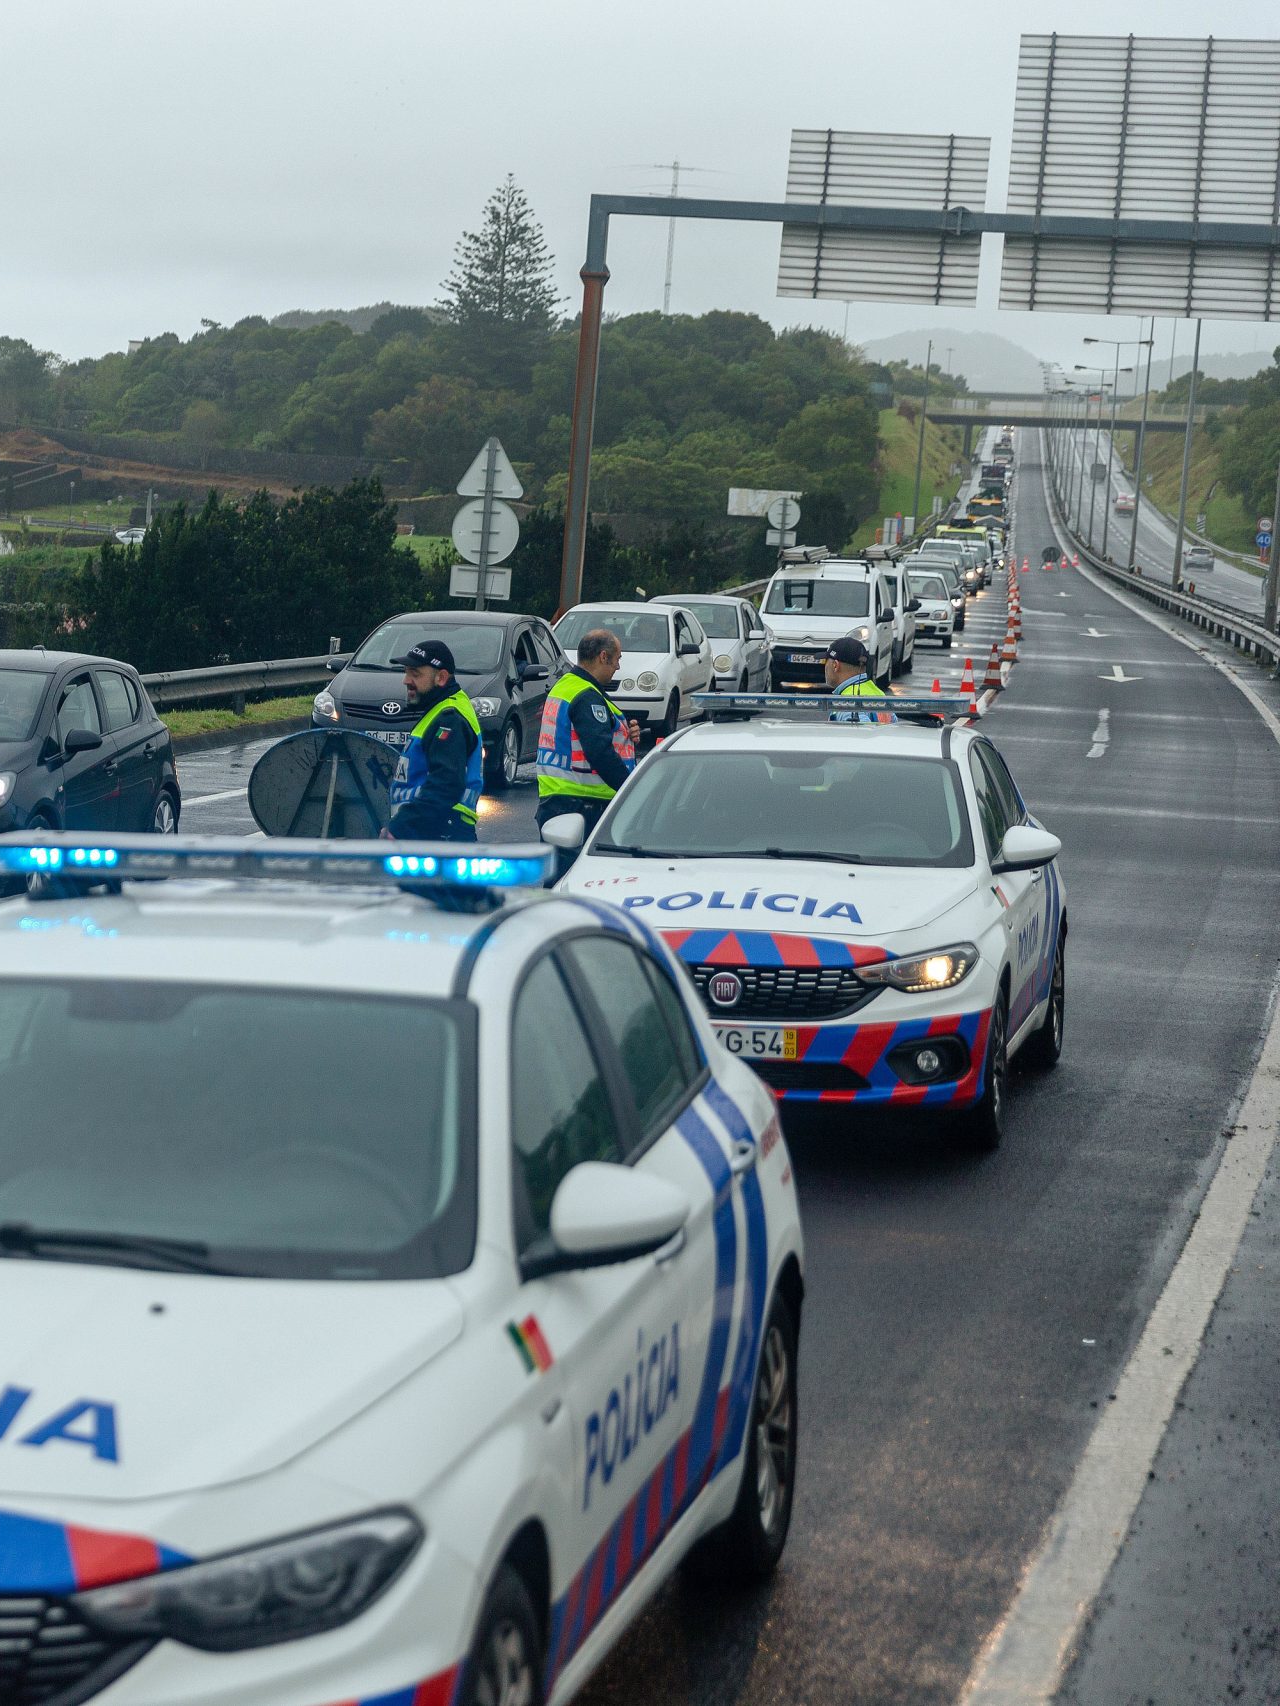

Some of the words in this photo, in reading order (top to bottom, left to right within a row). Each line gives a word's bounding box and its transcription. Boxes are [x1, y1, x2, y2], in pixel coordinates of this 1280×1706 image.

[1257, 535, 1271, 545] 40
[621, 887, 863, 924] POLÍCIA
[716, 981, 735, 998] FIAT
[785, 1031, 794, 1040] 19
[784, 1047, 795, 1056] 03
[581, 1321, 680, 1513] POLÍCIA
